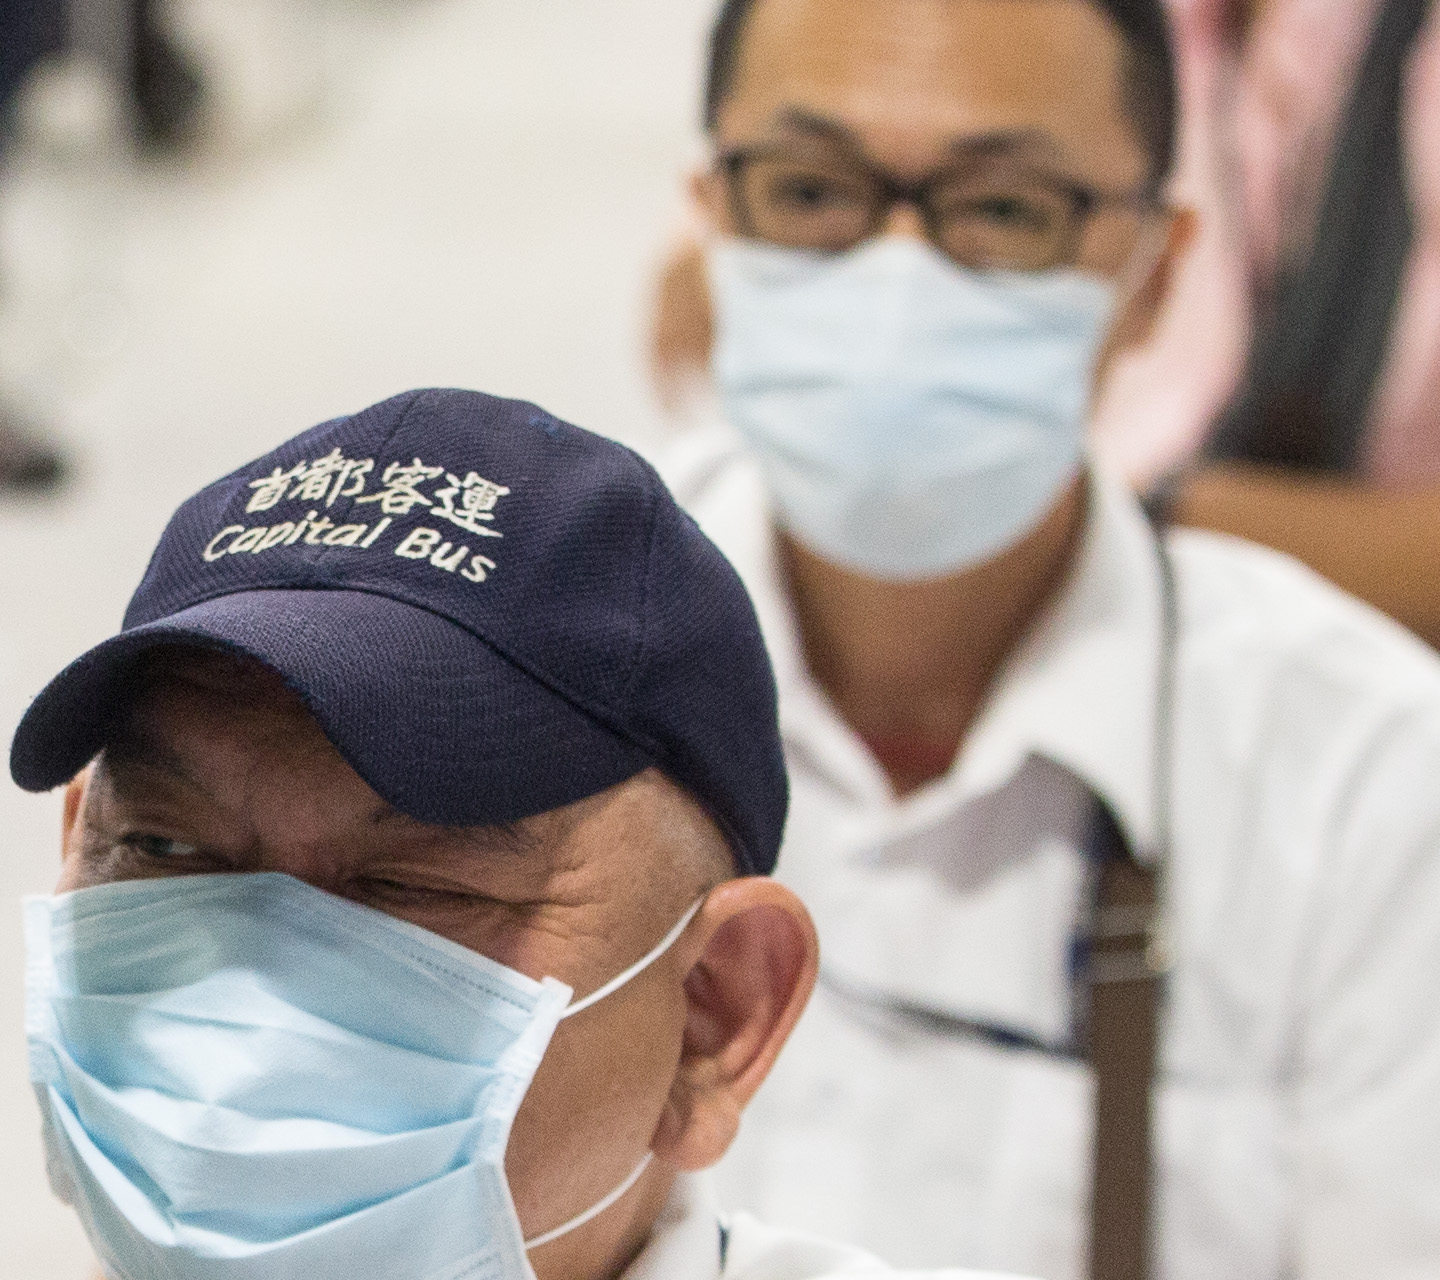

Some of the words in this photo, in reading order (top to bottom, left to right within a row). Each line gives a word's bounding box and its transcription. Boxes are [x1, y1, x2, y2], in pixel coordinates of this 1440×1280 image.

[245, 447, 511, 539] 首都客運
[203, 510, 393, 563] Capital
[394, 527, 497, 584] Bus
